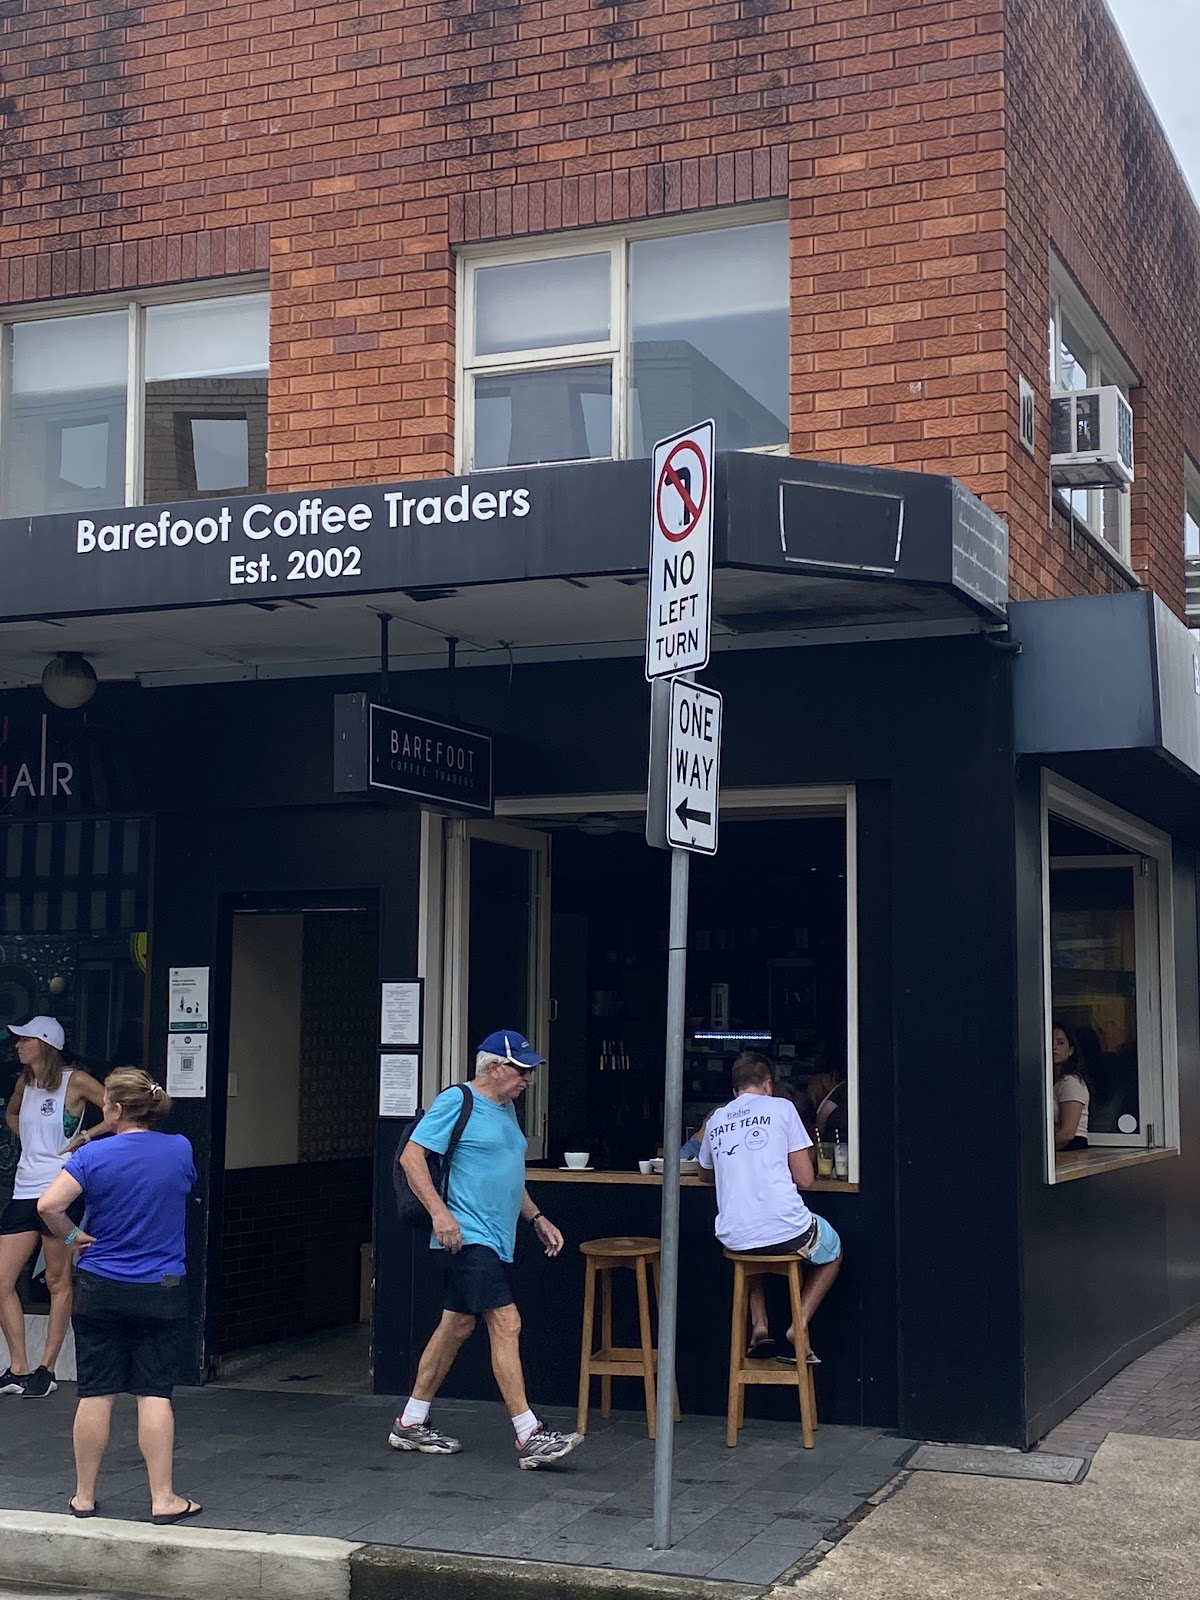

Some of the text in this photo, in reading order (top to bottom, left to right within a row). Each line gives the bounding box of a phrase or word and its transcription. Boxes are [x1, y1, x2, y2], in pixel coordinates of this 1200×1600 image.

[77, 484, 531, 553] Barefoot Coffee Traders
[230, 546, 362, 584] Est. 2002
[663, 550, 695, 592] NO
[659, 593, 699, 627] LEFT
[656, 628, 699, 661] TURN
[679, 699, 714, 742] ONE
[390, 729, 475, 773] BAREFOOT
[676, 747, 714, 791] WAY
[390, 759, 474, 788] COFFEE TRADERS
[709, 1115, 771, 1141] STATE TEAM
